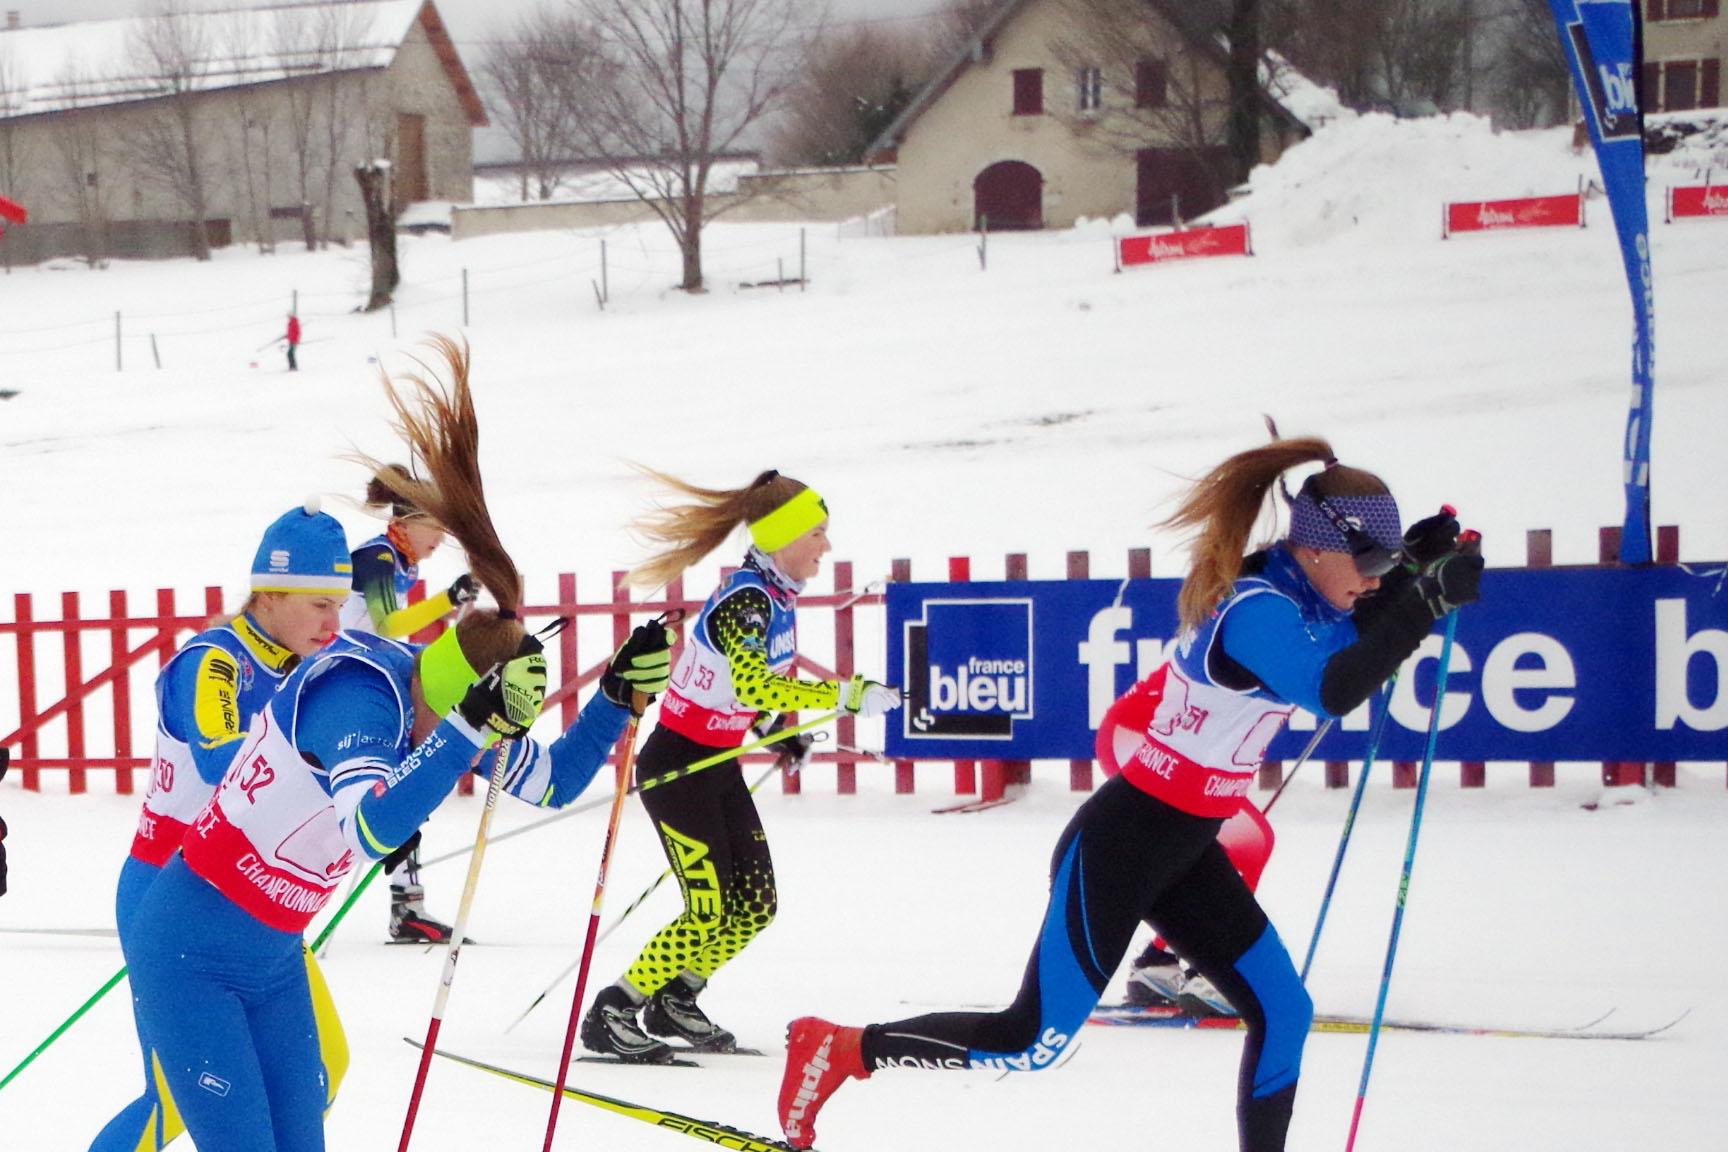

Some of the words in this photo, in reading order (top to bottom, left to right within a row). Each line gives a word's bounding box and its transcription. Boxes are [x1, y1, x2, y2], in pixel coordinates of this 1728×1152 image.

[693, 663, 716, 692] 53
[929, 664, 1026, 712] bleu
[969, 656, 1026, 675] france
[1078, 606, 1576, 732] frce
[240, 754, 276, 805] 52
